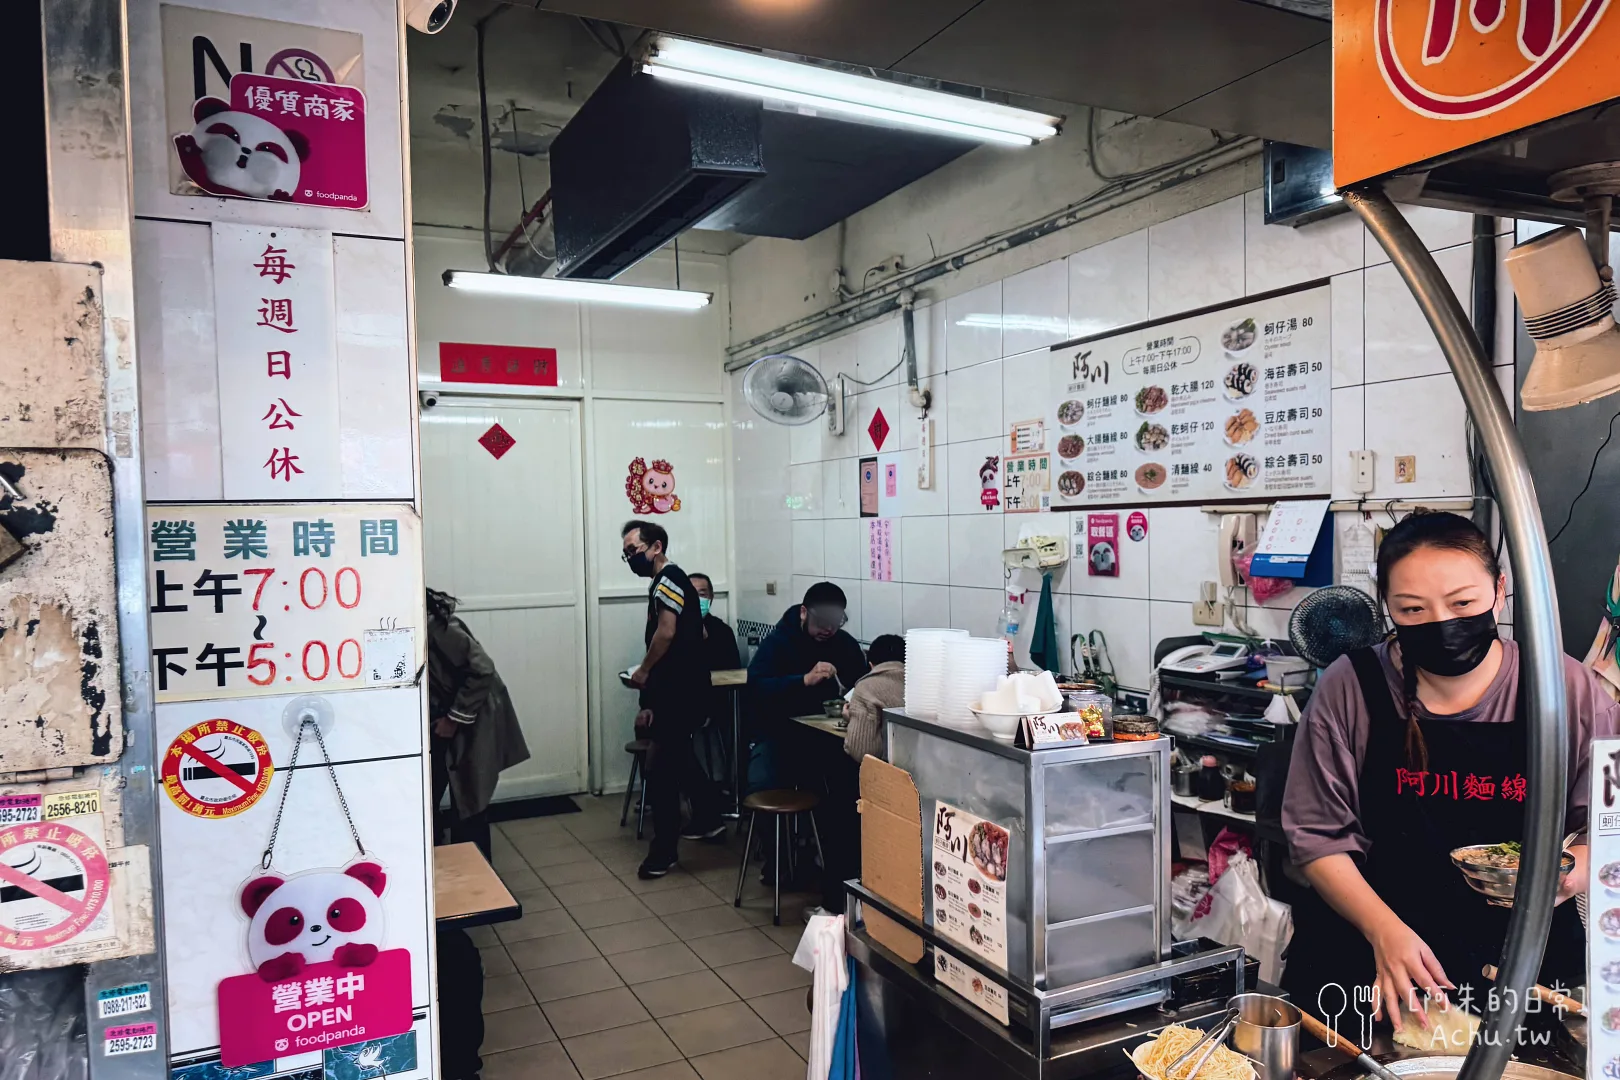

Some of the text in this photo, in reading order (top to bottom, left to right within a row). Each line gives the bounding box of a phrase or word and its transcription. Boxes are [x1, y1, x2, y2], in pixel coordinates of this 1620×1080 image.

[244, 85, 356, 123] 優質商家
[315, 189, 358, 203] foodpanda
[1264, 317, 1313, 336] 蚵仔湯 80
[253, 243, 305, 482] 每週日公休
[1072, 350, 1109, 384] 阿川
[1264, 361, 1322, 380] 海苔壽司 50
[1171, 380, 1214, 395] 乾大腸 120
[1087, 394, 1128, 409] 蚵仔麵線 80
[1264, 407, 1322, 424] 豆皮壽司 50
[1171, 421, 1214, 435] 乾蚵仔 120
[1087, 431, 1128, 446] 大腸麵線 80
[1006, 457, 1047, 473] 營業時間
[1171, 462, 1212, 476] 清麵線 40
[1264, 453, 1322, 469] 綜合壽司 50
[1087, 470, 1128, 482] 綜合麵線 80
[151, 518, 399, 562] 營業時間
[170, 720, 269, 758] 本場所禁止吸菸
[1395, 767, 1527, 802] 阿川麵線
[0, 807, 38, 822] 95-2723
[47, 800, 98, 818] 2556-8210
[222, 800, 249, 815] Maximum
[937, 806, 968, 863] 阿川
[272, 971, 365, 1014] 營業中
[287, 1004, 352, 1032] OPEN
[109, 1035, 153, 1053] 2595-2723
[295, 1024, 366, 1047] foodpanda
